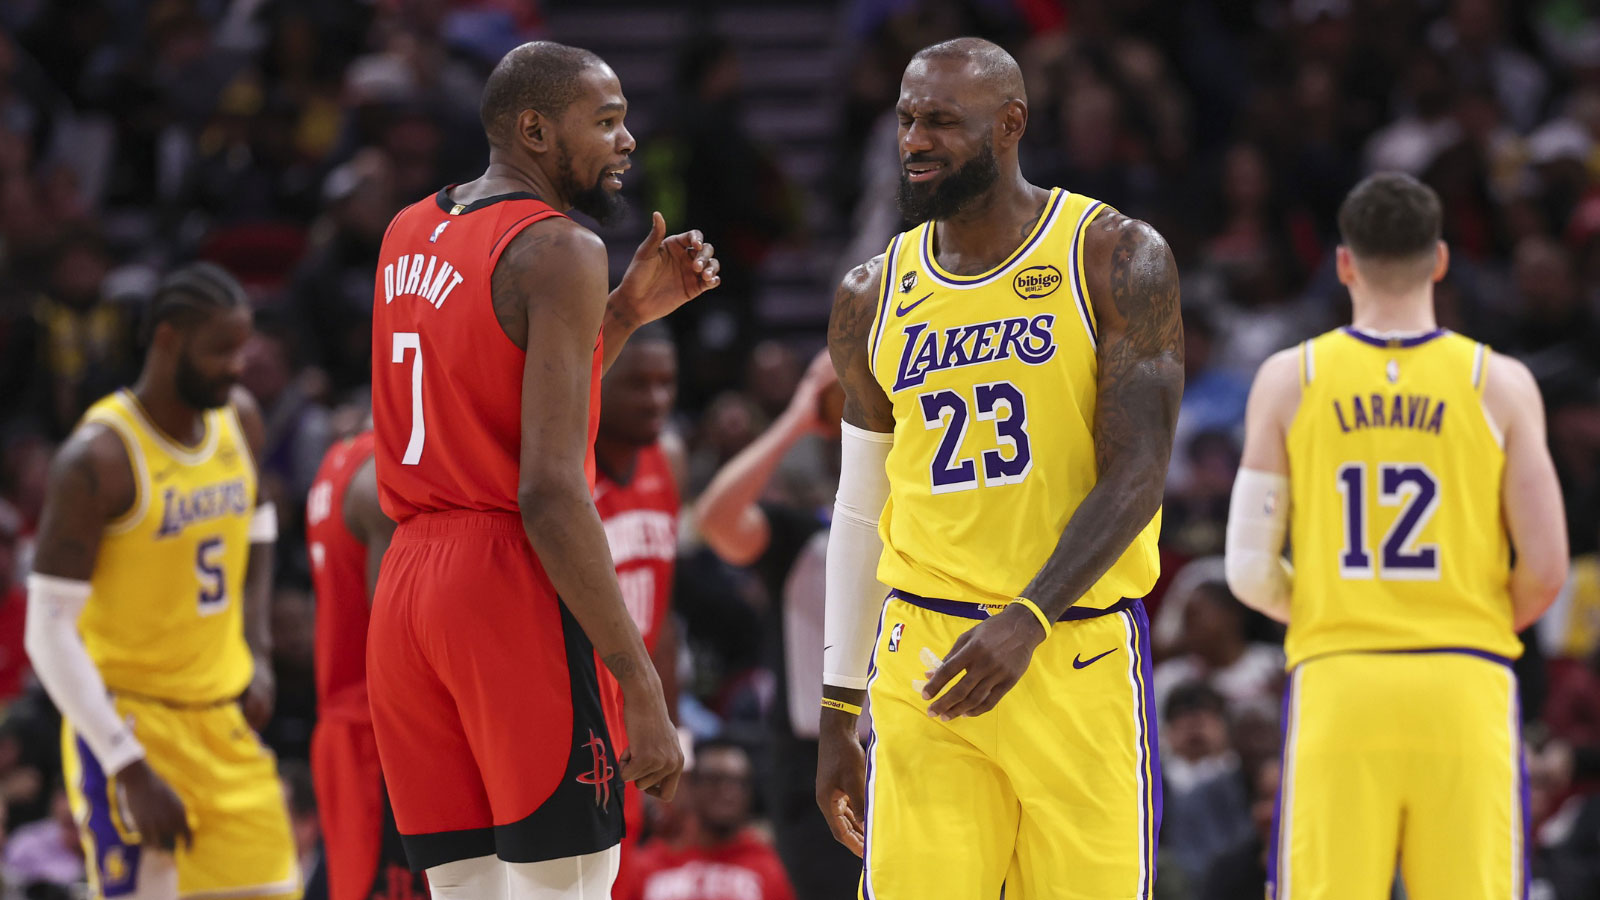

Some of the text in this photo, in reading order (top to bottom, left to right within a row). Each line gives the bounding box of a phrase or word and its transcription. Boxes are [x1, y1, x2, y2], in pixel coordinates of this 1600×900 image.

[384, 253, 464, 309] DURANT
[1018, 274, 1059, 287] bibigo
[892, 313, 1058, 394] LAKERS
[392, 332, 425, 465] 7
[917, 380, 1033, 495] 23
[1334, 394, 1445, 436] LARAVIA
[1337, 461, 1441, 581] 12
[195, 533, 231, 617] 5
